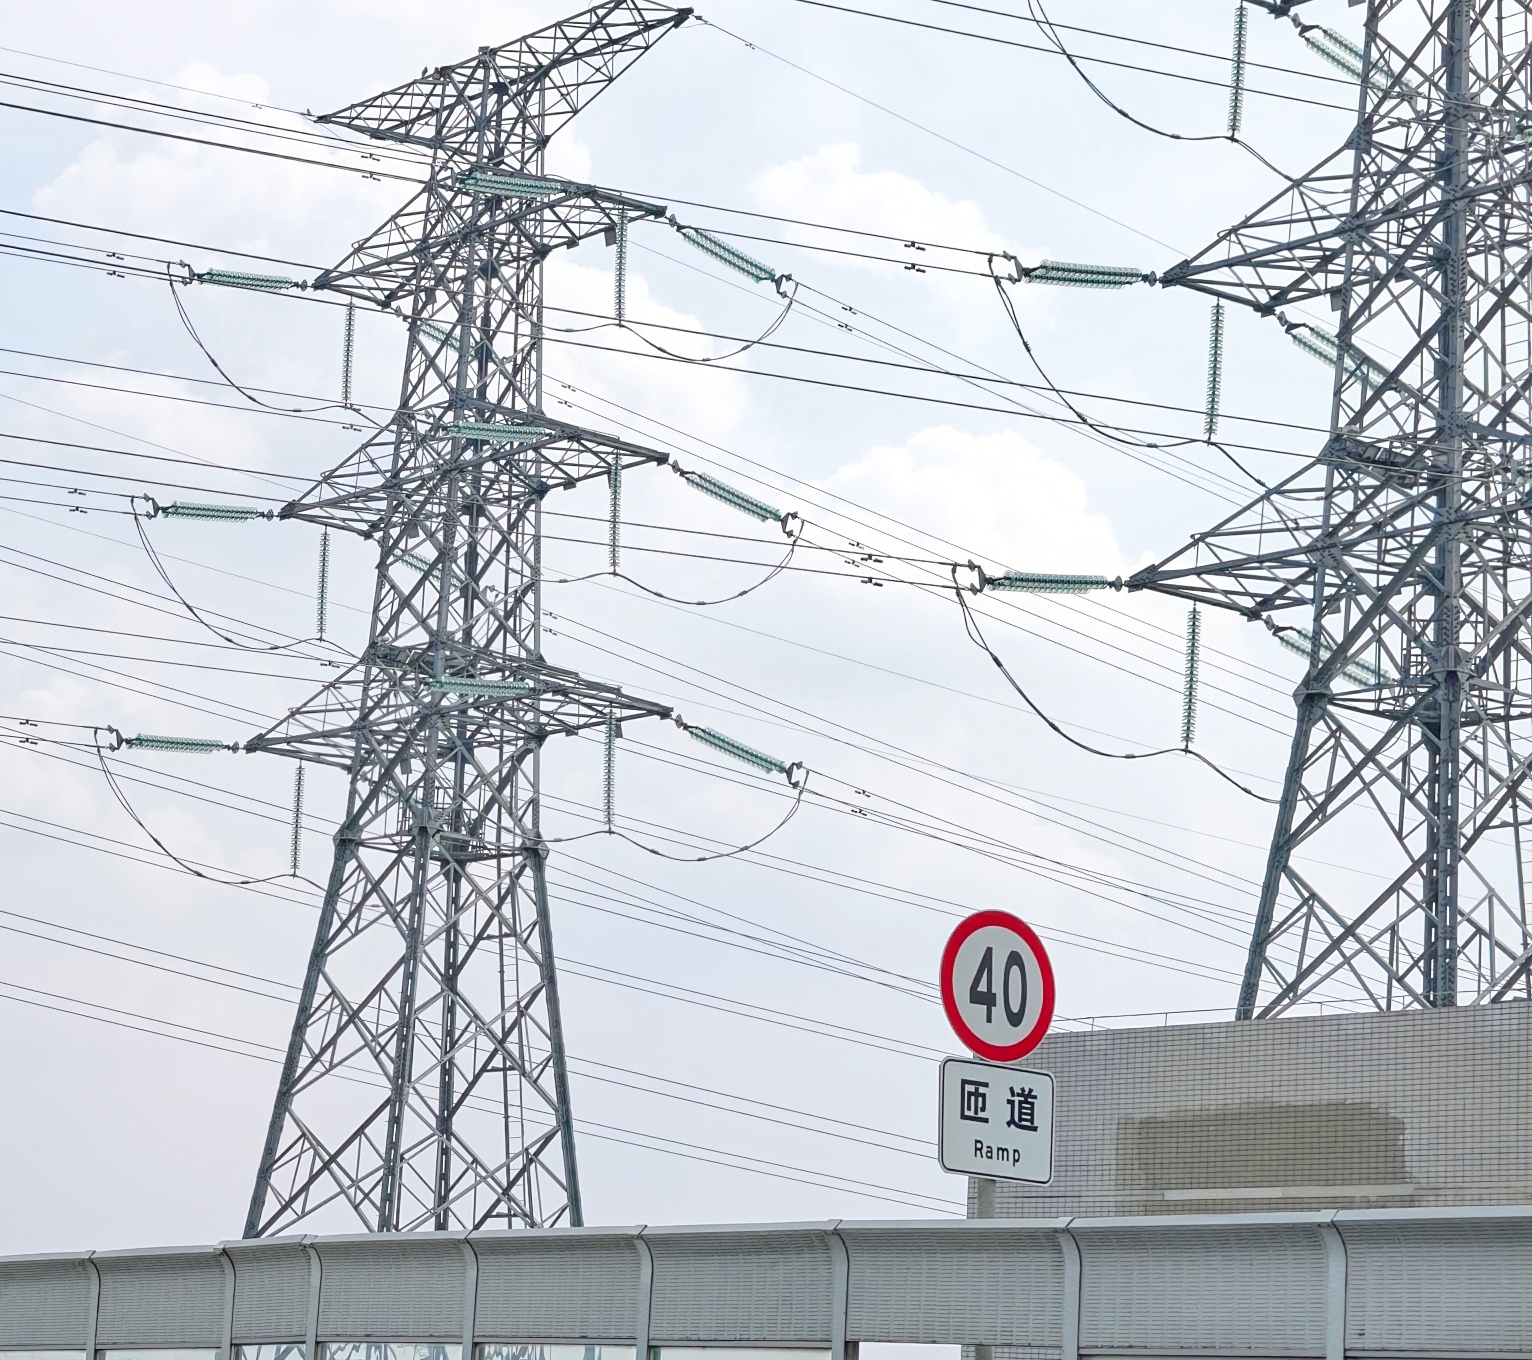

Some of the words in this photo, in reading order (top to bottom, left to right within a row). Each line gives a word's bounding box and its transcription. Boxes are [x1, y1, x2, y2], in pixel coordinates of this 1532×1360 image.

[969, 946, 1028, 1028] 40
[960, 1078, 1039, 1132] 匝道
[974, 1138, 1021, 1167] Ramp
